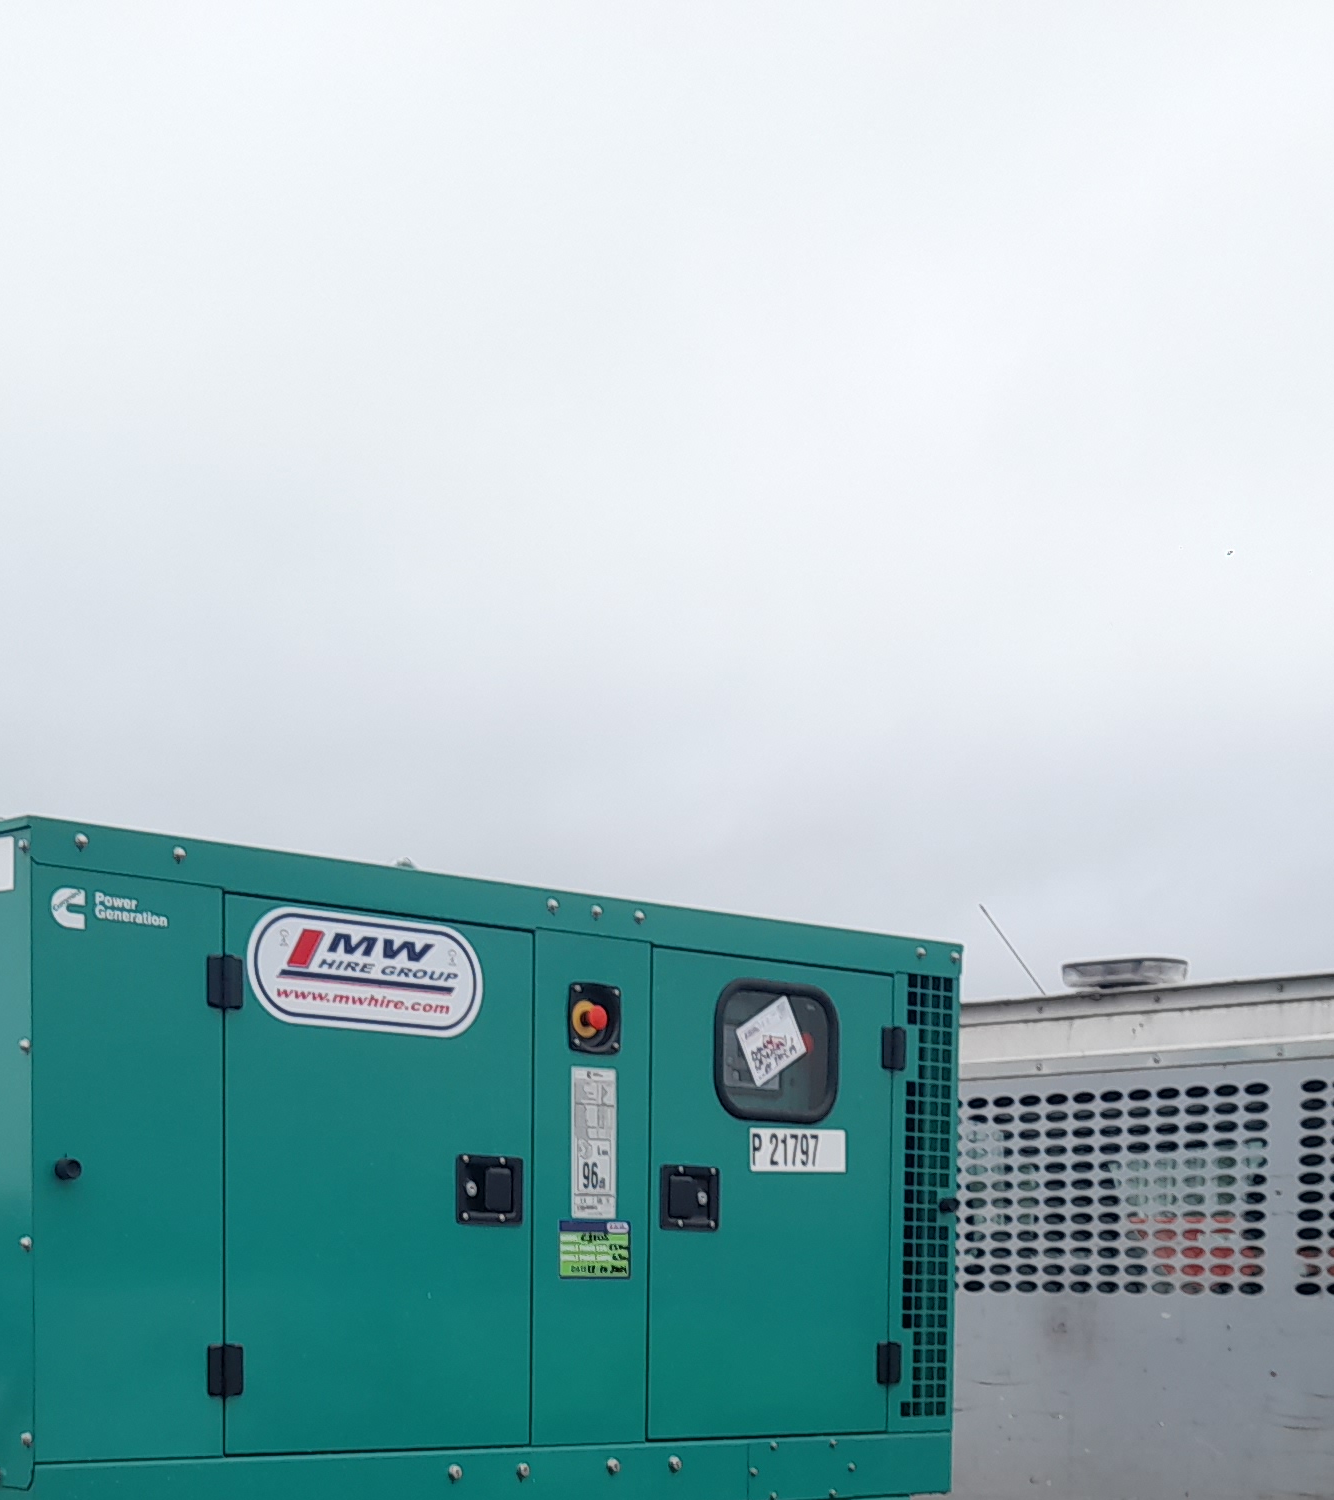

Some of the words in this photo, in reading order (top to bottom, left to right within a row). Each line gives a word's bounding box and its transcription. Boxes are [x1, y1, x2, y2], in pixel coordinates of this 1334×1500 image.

[94, 891, 138, 910] Power
[94, 904, 168, 928] Generation
[326, 932, 435, 963] MW
[318, 958, 375, 975] HIRE
[381, 965, 459, 983] GROUP
[276, 987, 451, 1015] www.mwhire.com
[752, 1133, 762, 1167] P
[769, 1133, 819, 1168] 21797
[582, 1161, 598, 1189] 96
